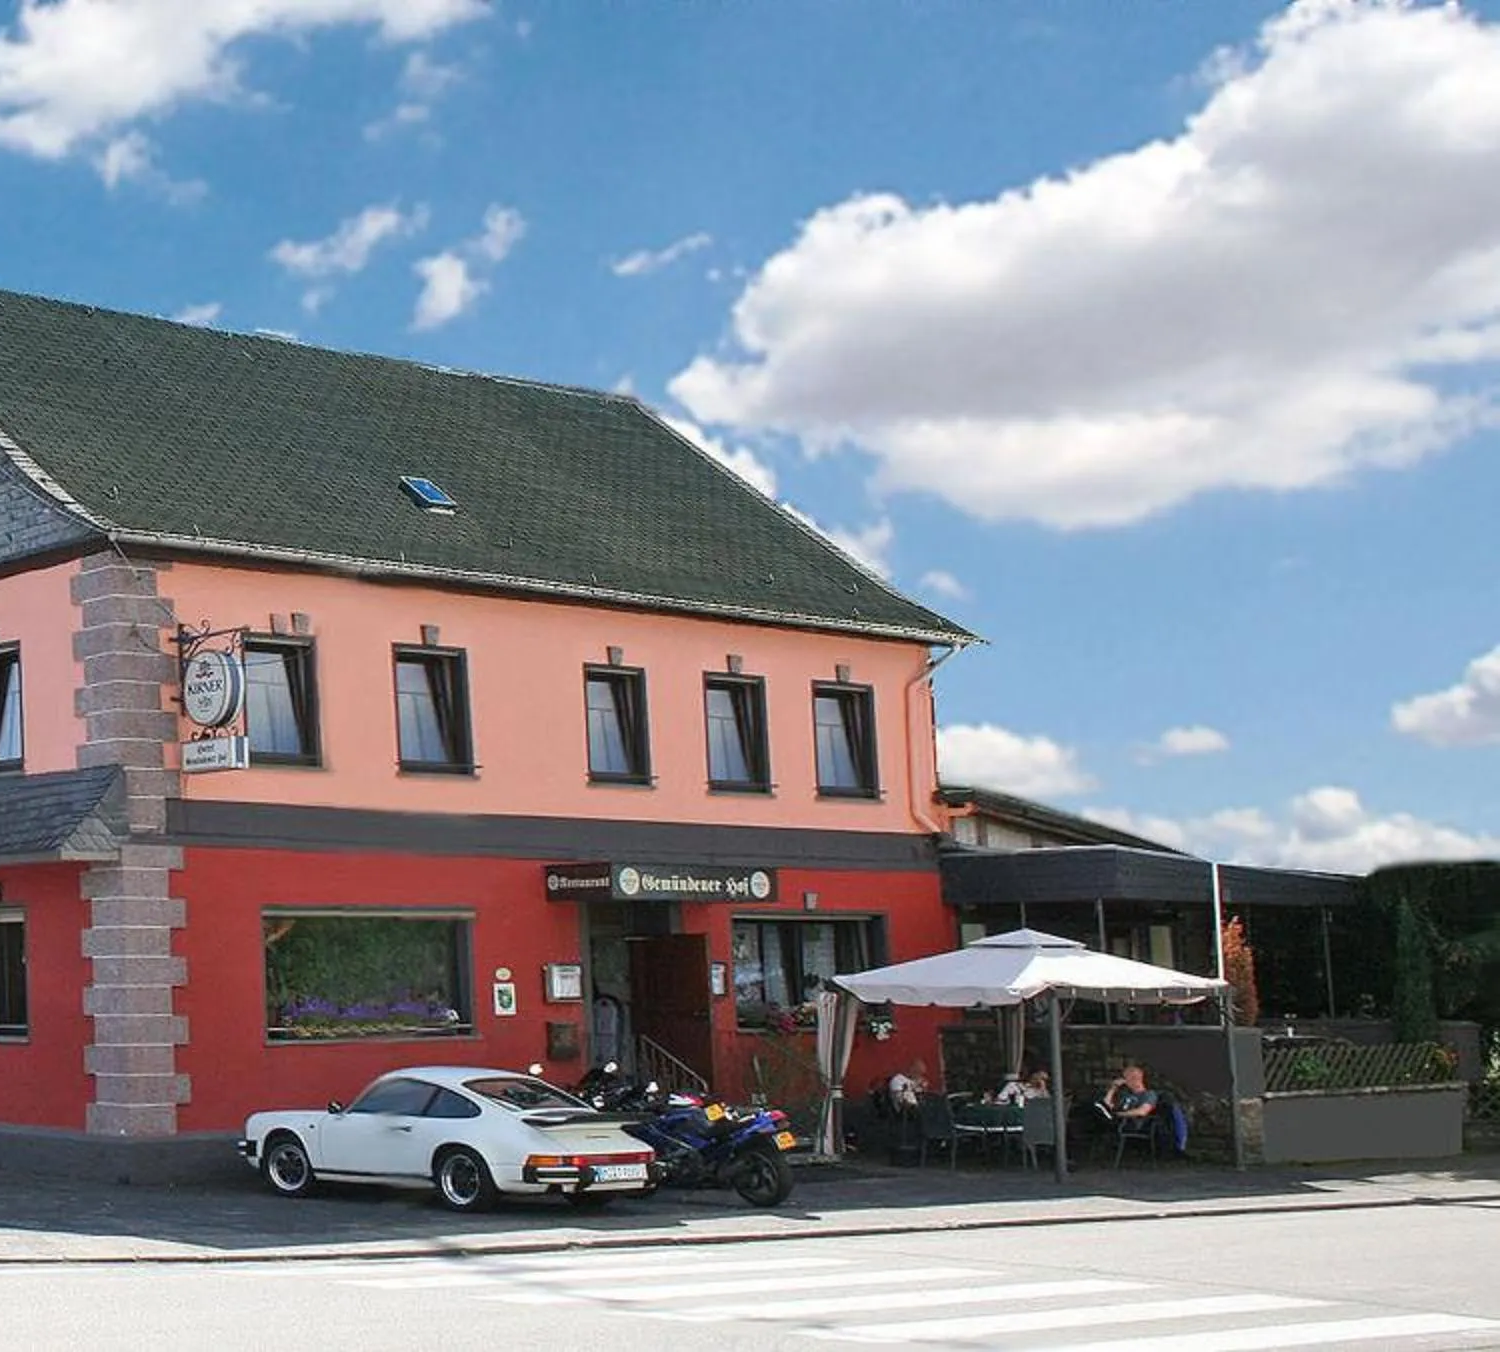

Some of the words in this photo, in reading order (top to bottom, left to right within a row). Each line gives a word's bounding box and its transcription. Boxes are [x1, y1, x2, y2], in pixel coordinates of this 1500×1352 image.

[560, 876, 610, 888] Restaurant
[641, 873, 721, 892] Gemündener
[726, 877, 749, 897] Hof
